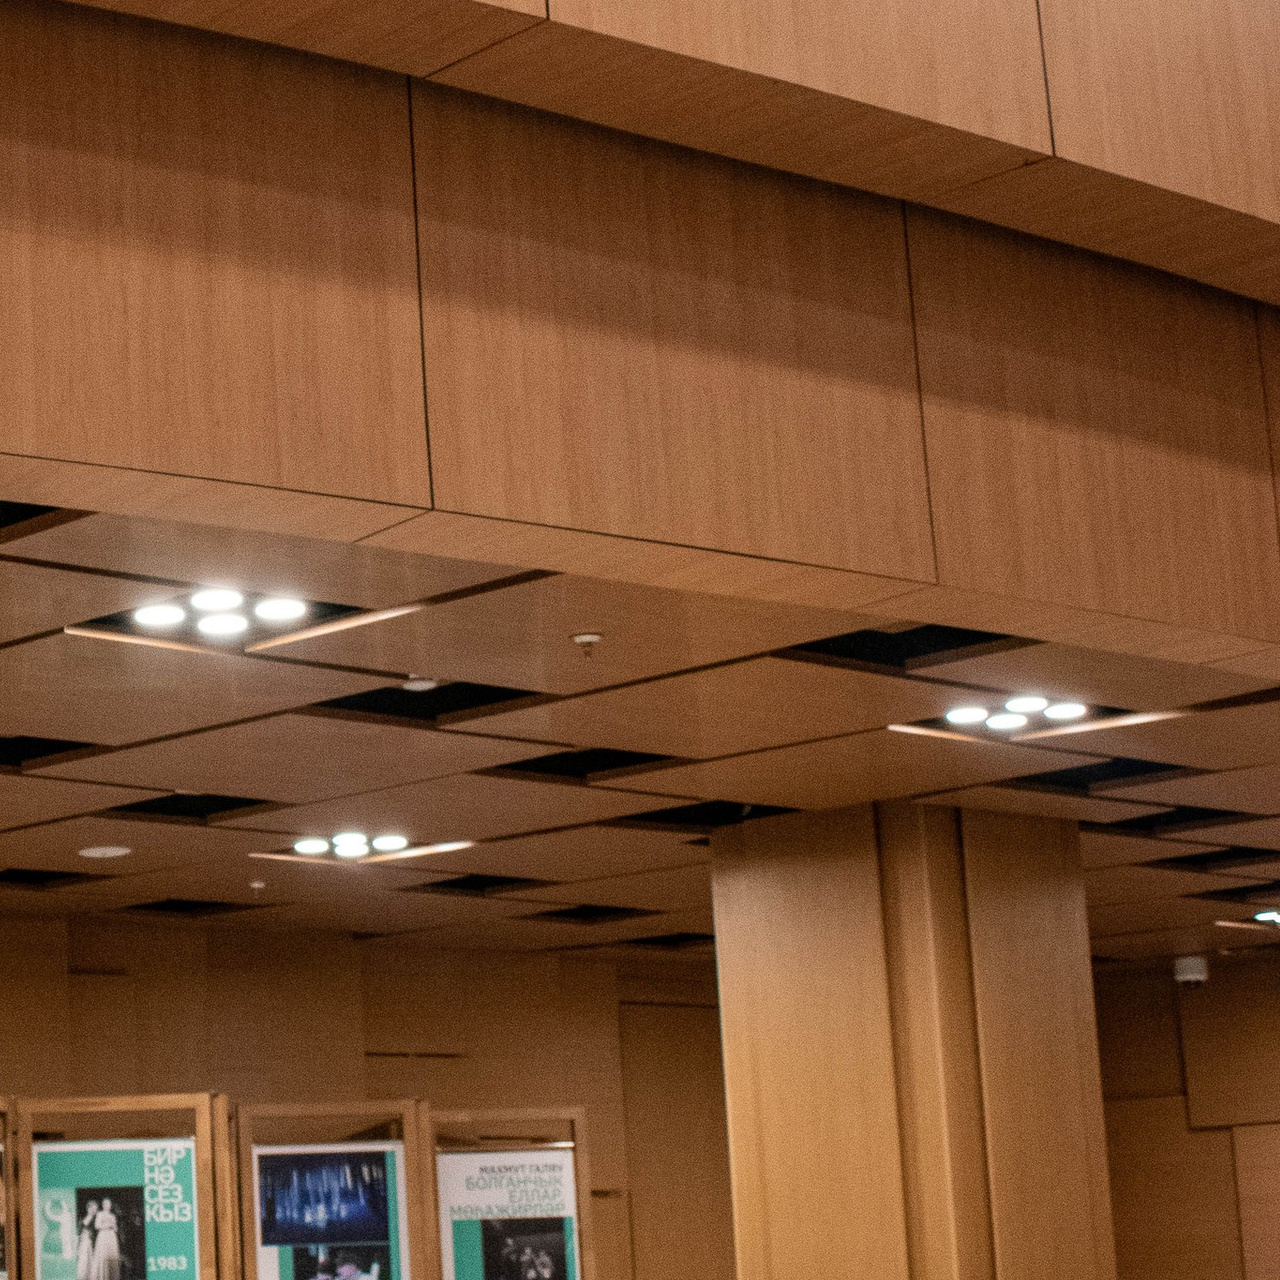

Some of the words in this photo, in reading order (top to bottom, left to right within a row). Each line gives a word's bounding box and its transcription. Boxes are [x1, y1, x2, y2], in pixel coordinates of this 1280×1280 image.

[145, 1184, 183, 1204] СЕЗ
[146, 1202, 192, 1223] КЫЗ
[149, 1256, 188, 1271] 1983
